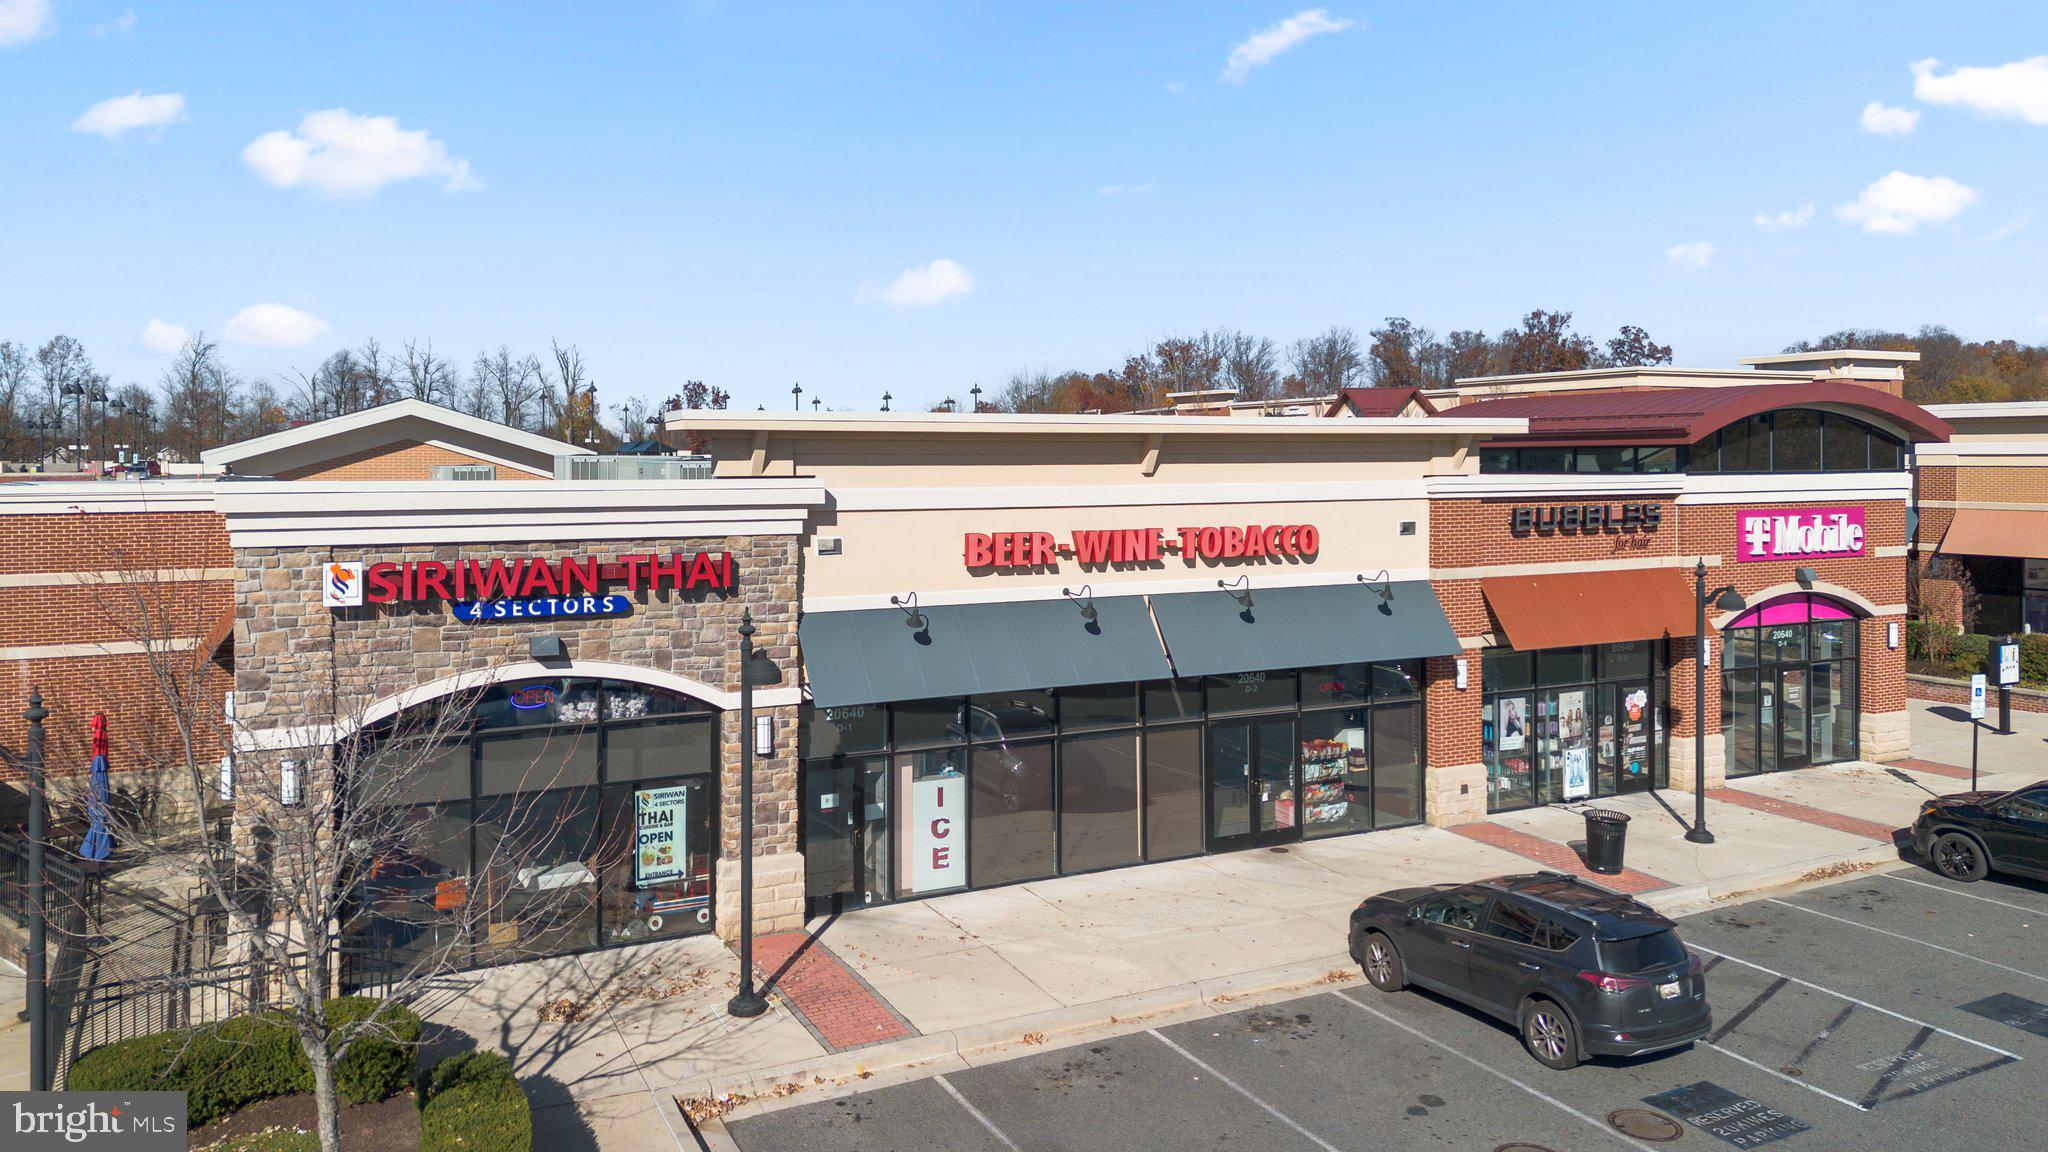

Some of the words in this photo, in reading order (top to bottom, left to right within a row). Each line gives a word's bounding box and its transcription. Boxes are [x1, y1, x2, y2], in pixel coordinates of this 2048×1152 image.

[1513, 503, 1662, 532] BUBBLES
[1610, 536, 1630, 555] for
[1630, 534, 1651, 550] hair
[367, 555, 598, 603] SIRIWAN
[617, 551, 732, 592] THAI
[470, 604, 482, 618] 4
[495, 596, 615, 618] SECTORS
[1773, 629, 1793, 640] 20640
[1238, 672, 1266, 684] 20640
[513, 688, 556, 705] OPEN
[1245, 685, 1258, 693] D-2
[826, 706, 865, 721] 20640
[837, 723, 853, 732] D-1
[653, 791, 685, 800] SIRIWAN
[659, 799, 685, 807] SECTORS
[640, 810, 673, 825] THAI
[930, 786, 950, 870] ICE
[639, 831, 673, 845] OPEN
